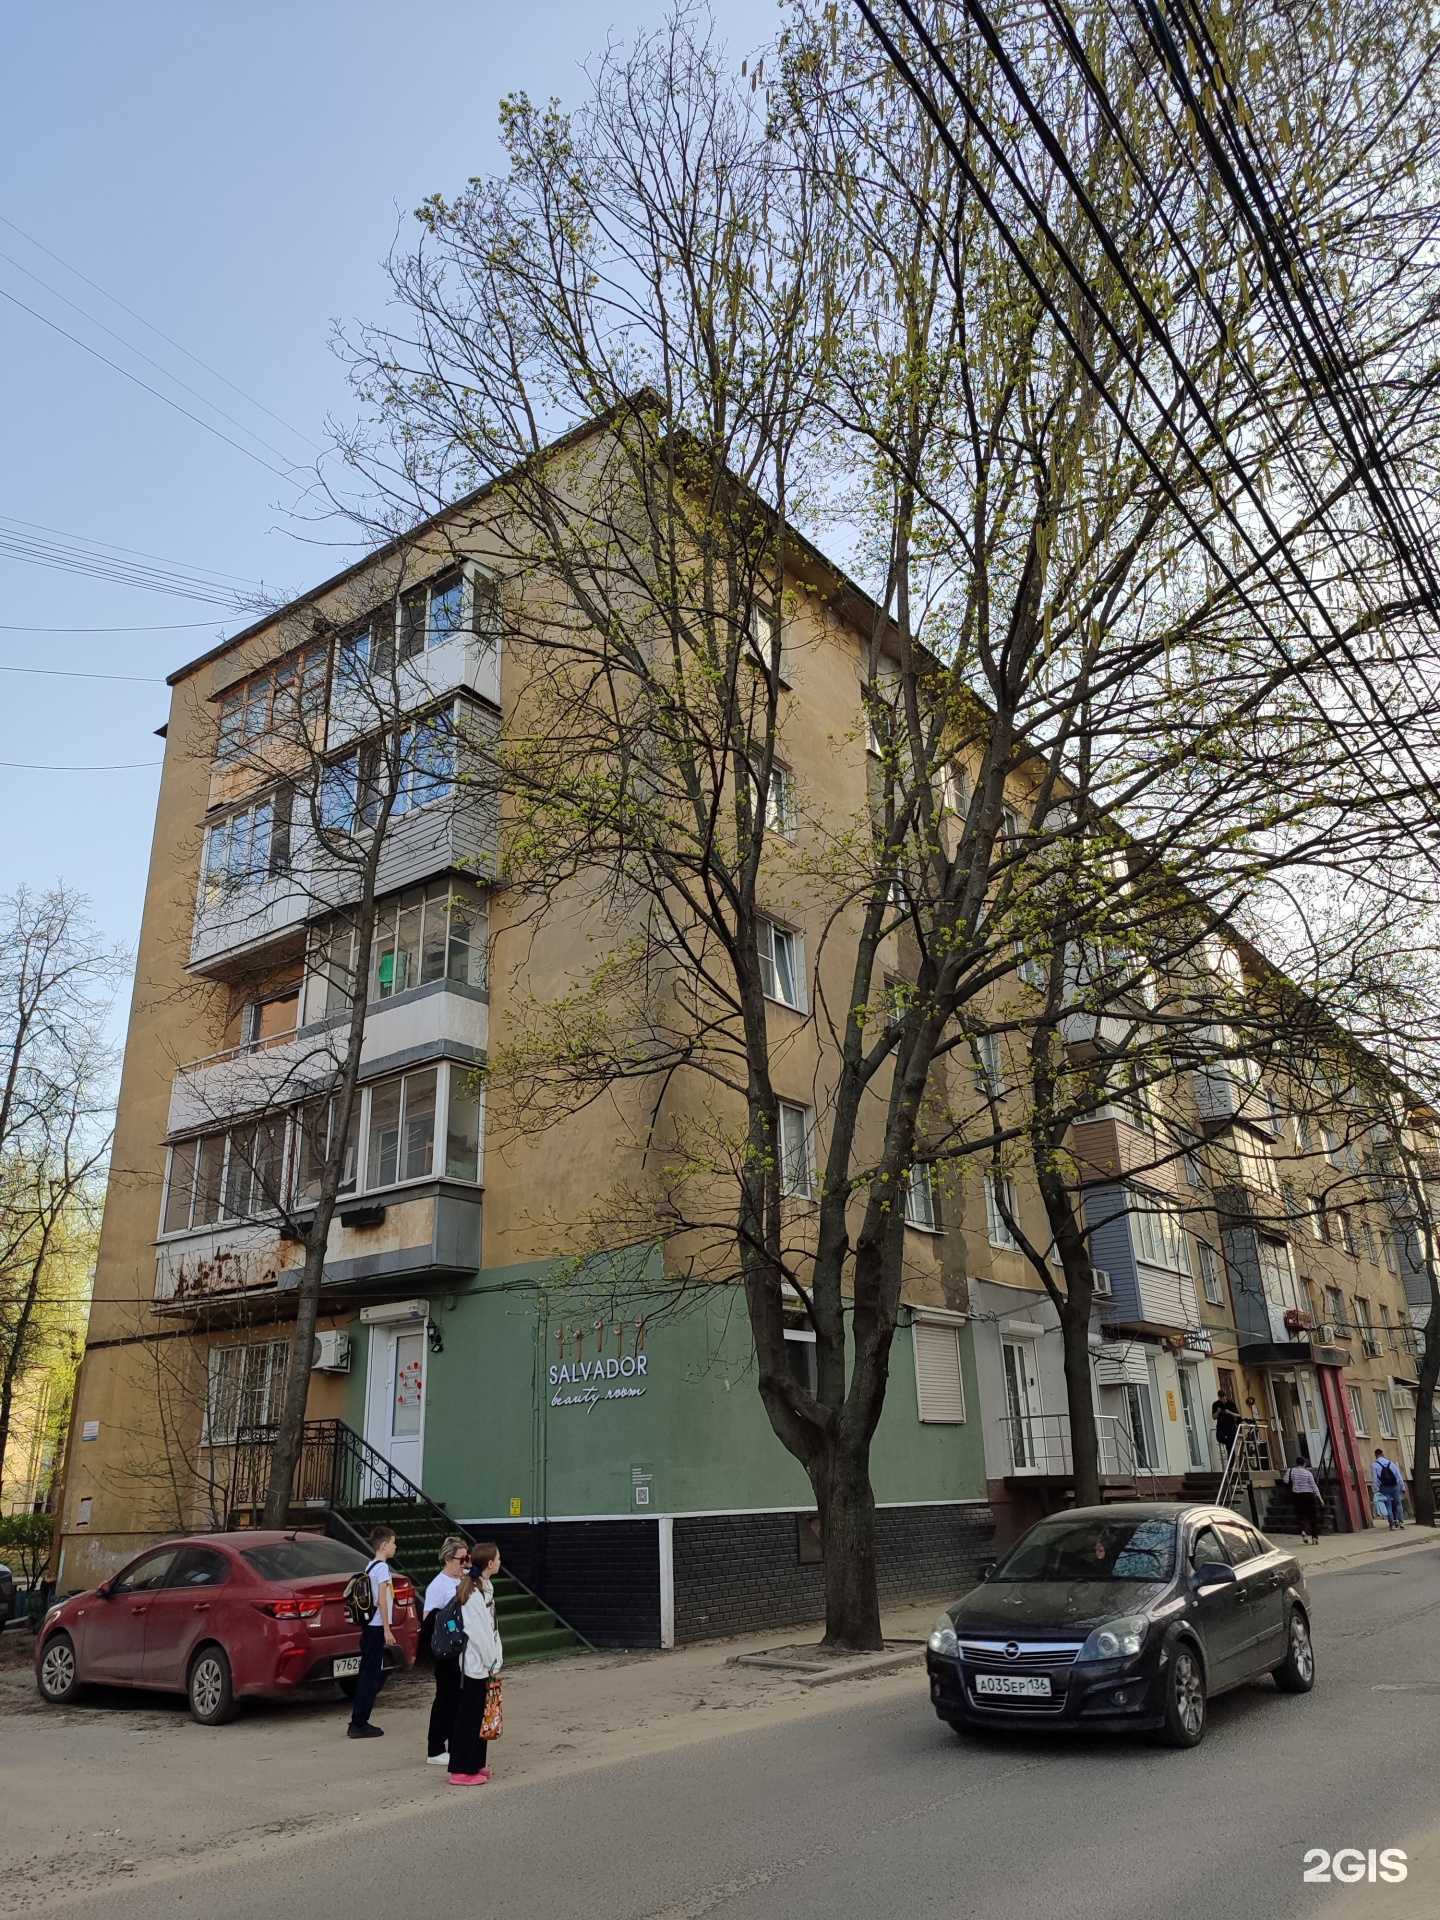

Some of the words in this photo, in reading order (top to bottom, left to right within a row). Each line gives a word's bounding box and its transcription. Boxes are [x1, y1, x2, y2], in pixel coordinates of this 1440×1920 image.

[549, 1355, 648, 1385] SALVADOR
[551, 1386, 600, 1415] beauty
[604, 1387, 647, 1400] room
